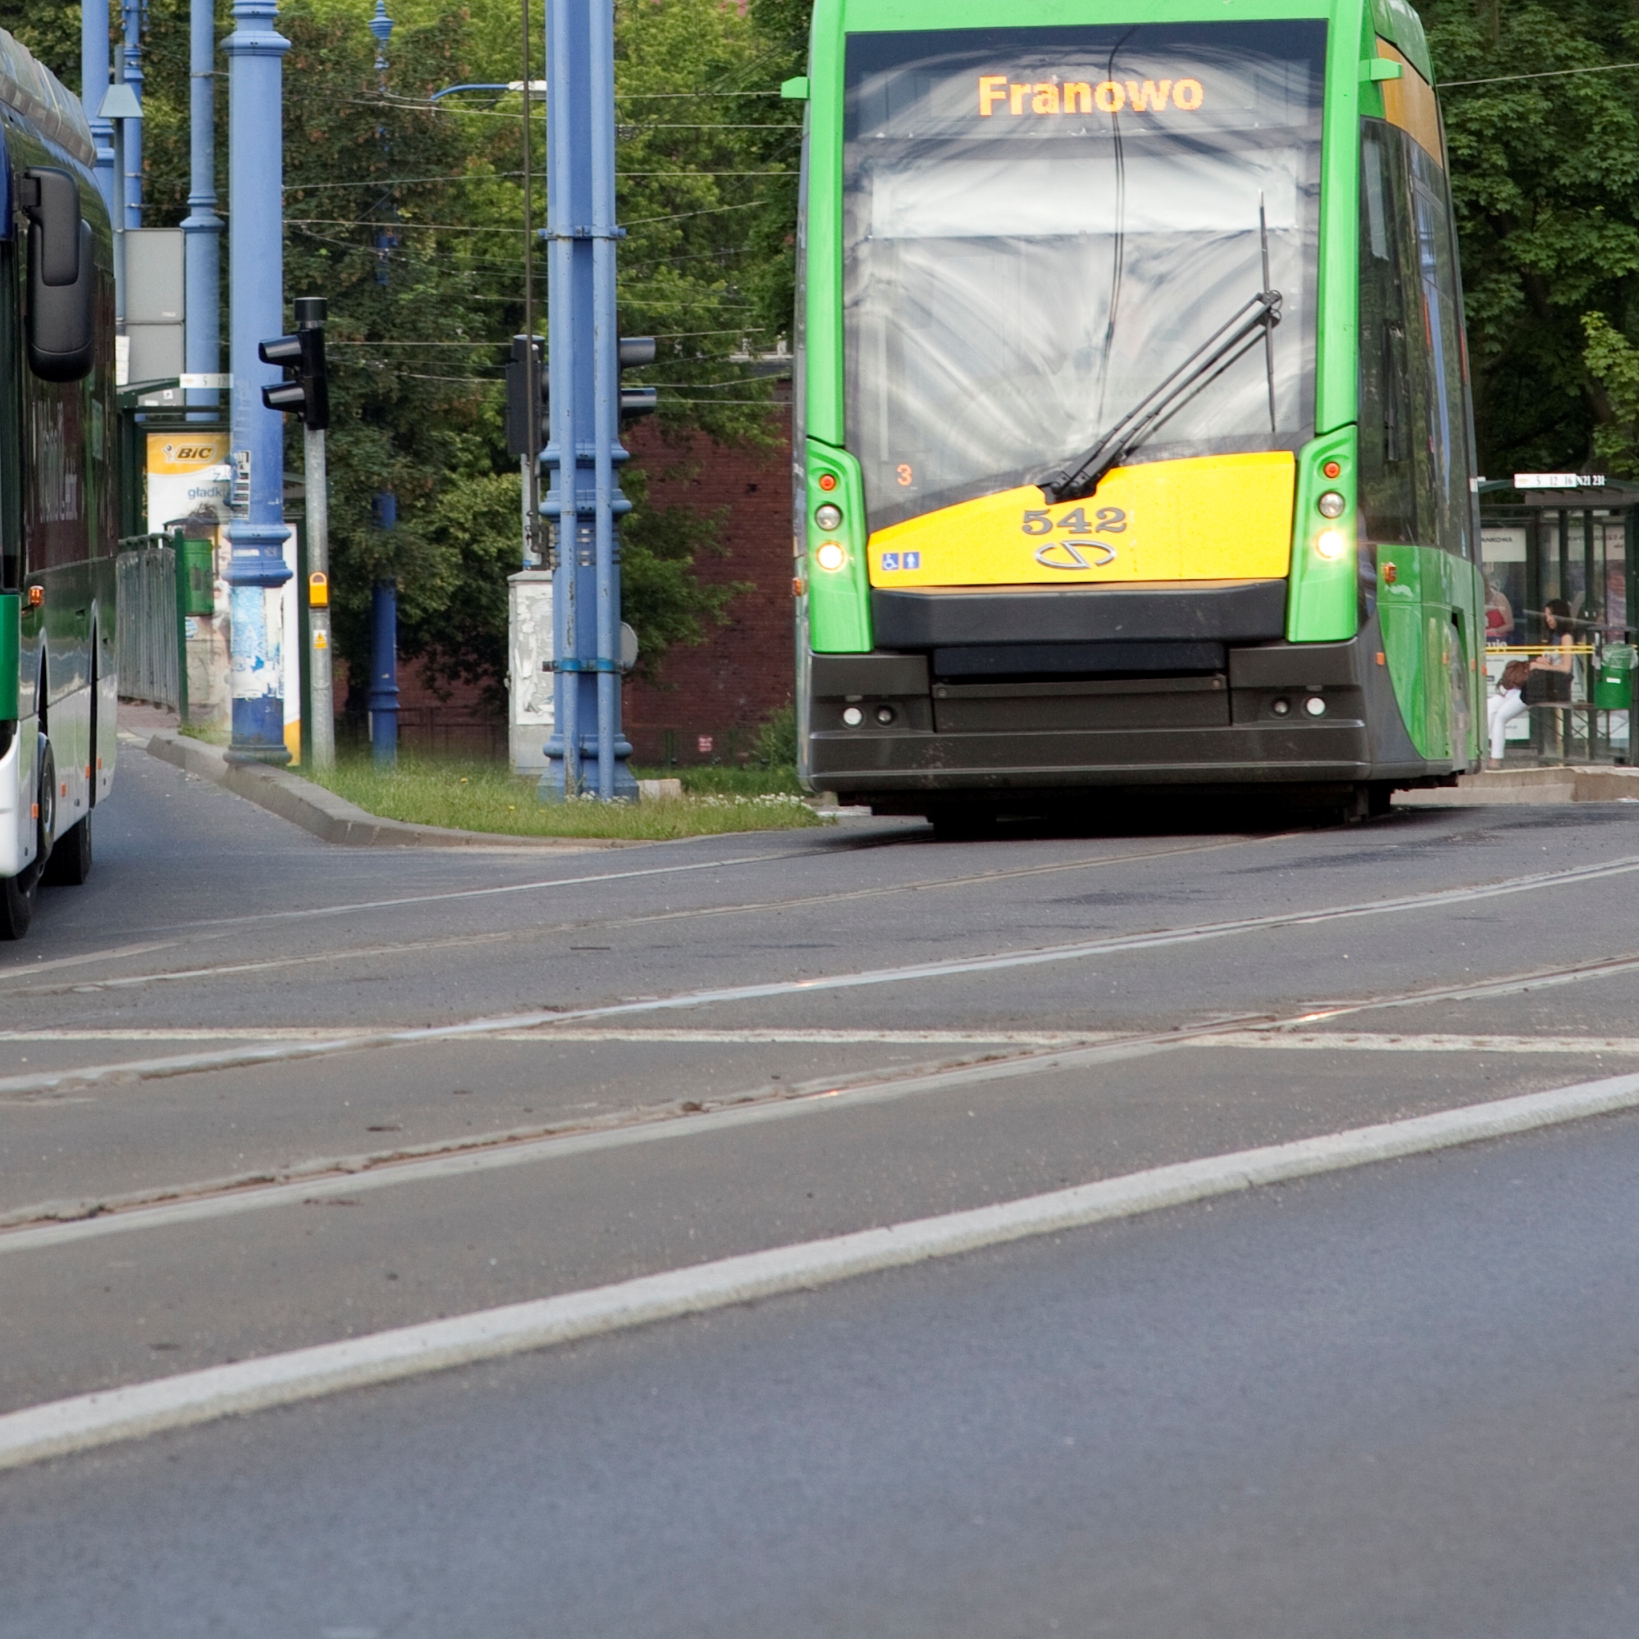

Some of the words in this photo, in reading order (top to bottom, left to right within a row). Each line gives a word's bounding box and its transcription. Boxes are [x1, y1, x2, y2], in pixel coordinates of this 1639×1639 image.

[978, 75, 1204, 116] Franowo
[896, 464, 913, 486] 3
[1550, 475, 1558, 486] 12
[1021, 507, 1128, 535] 542
